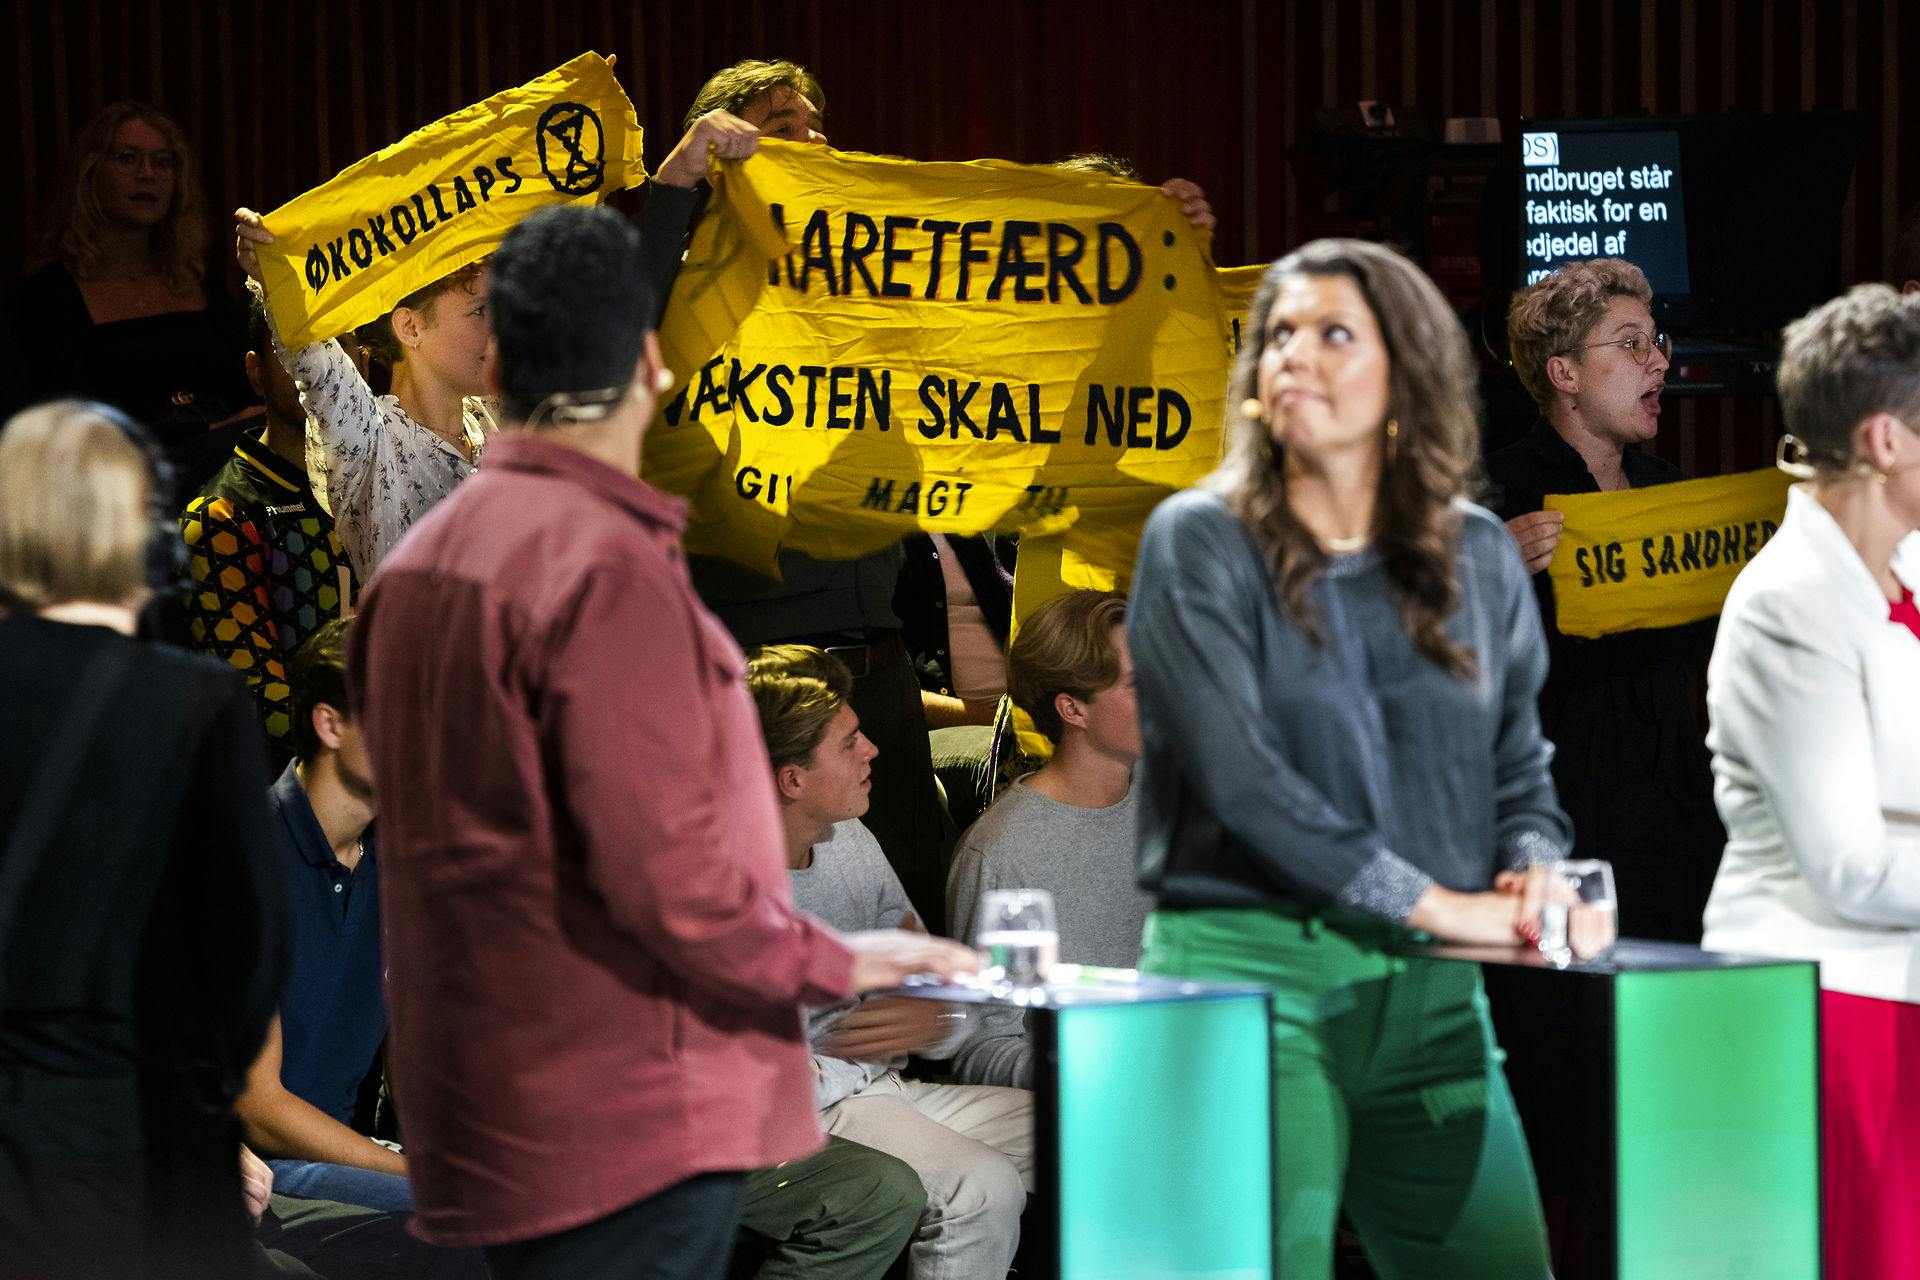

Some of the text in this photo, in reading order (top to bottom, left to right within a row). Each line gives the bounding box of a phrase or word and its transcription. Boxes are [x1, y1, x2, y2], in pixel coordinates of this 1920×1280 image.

[1525, 163, 1673, 196] ndbruget står
[305, 157, 522, 296] ØKOKOLLAPS
[1525, 197, 1667, 225] faktisk for en
[1604, 229, 1627, 256] af
[918, 374, 1061, 444] SKAL
[1085, 383, 1192, 450] NED
[861, 477, 972, 516] MAGT
[1575, 541, 1627, 588] SIG
